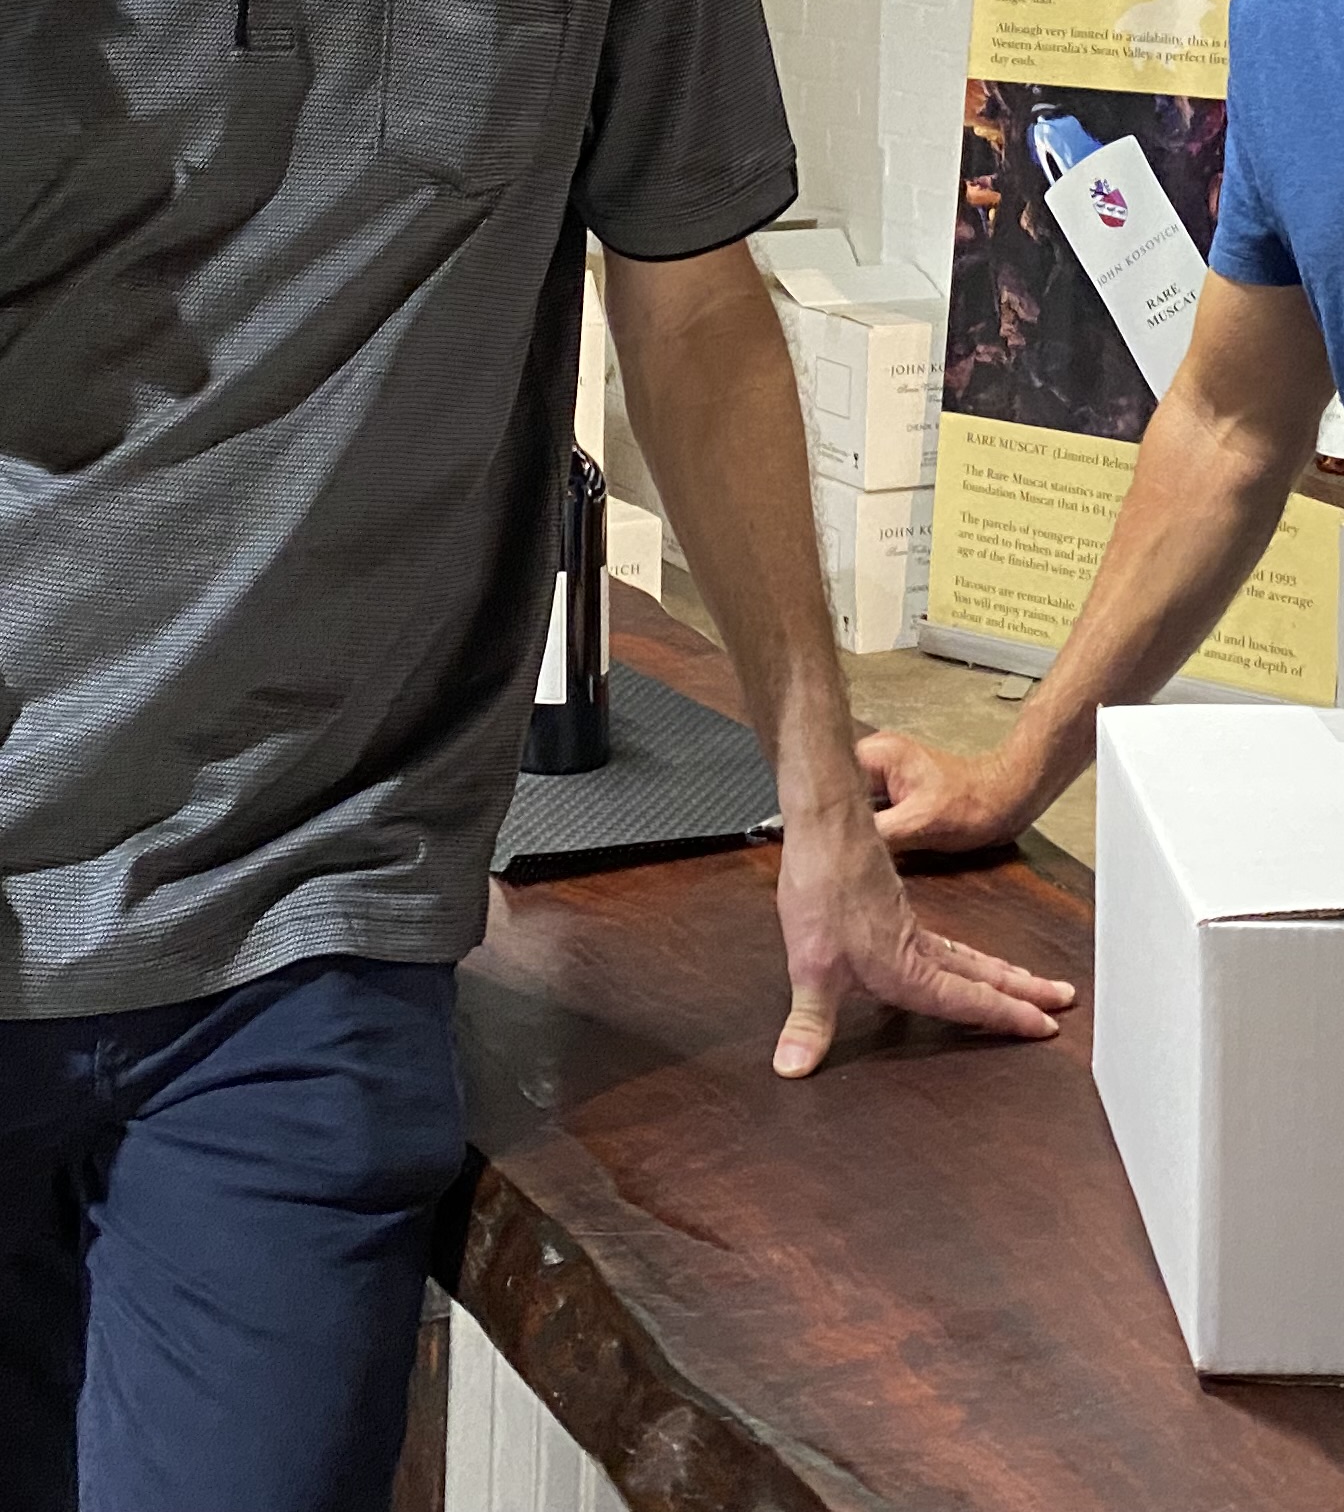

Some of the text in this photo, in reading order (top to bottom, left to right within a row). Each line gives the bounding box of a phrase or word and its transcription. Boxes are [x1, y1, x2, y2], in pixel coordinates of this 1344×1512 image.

[1046, 28, 1108, 40] very limited
[991, 38, 1032, 50] Western
[1034, 41, 1088, 54] Australia's
[1090, 44, 1119, 56] Swan
[1166, 52, 1206, 65] perfect
[1096, 224, 1180, 288] JOHN KOSOVICH
[1145, 282, 1181, 310] RARE
[1146, 289, 1197, 330] MUSCAT
[890, 363, 926, 378] JOHN
[966, 432, 1099, 466] RARE MUSCAT (Limited
[962, 479, 1090, 513] foundation Muscat that is
[964, 463, 1113, 501] The Rare Muscat statistics are
[879, 525, 915, 541] JOHN
[960, 510, 1073, 545] The parcels of younger
[1008, 554, 1049, 572] finished
[1051, 563, 1075, 578] wine
[1269, 571, 1297, 587] 1993
[954, 576, 1076, 610] Flavours are remarkable.
[1246, 585, 1315, 609] the average
[1223, 635, 1296, 658] and luscious.
[1204, 649, 1306, 678] amazing depth of
